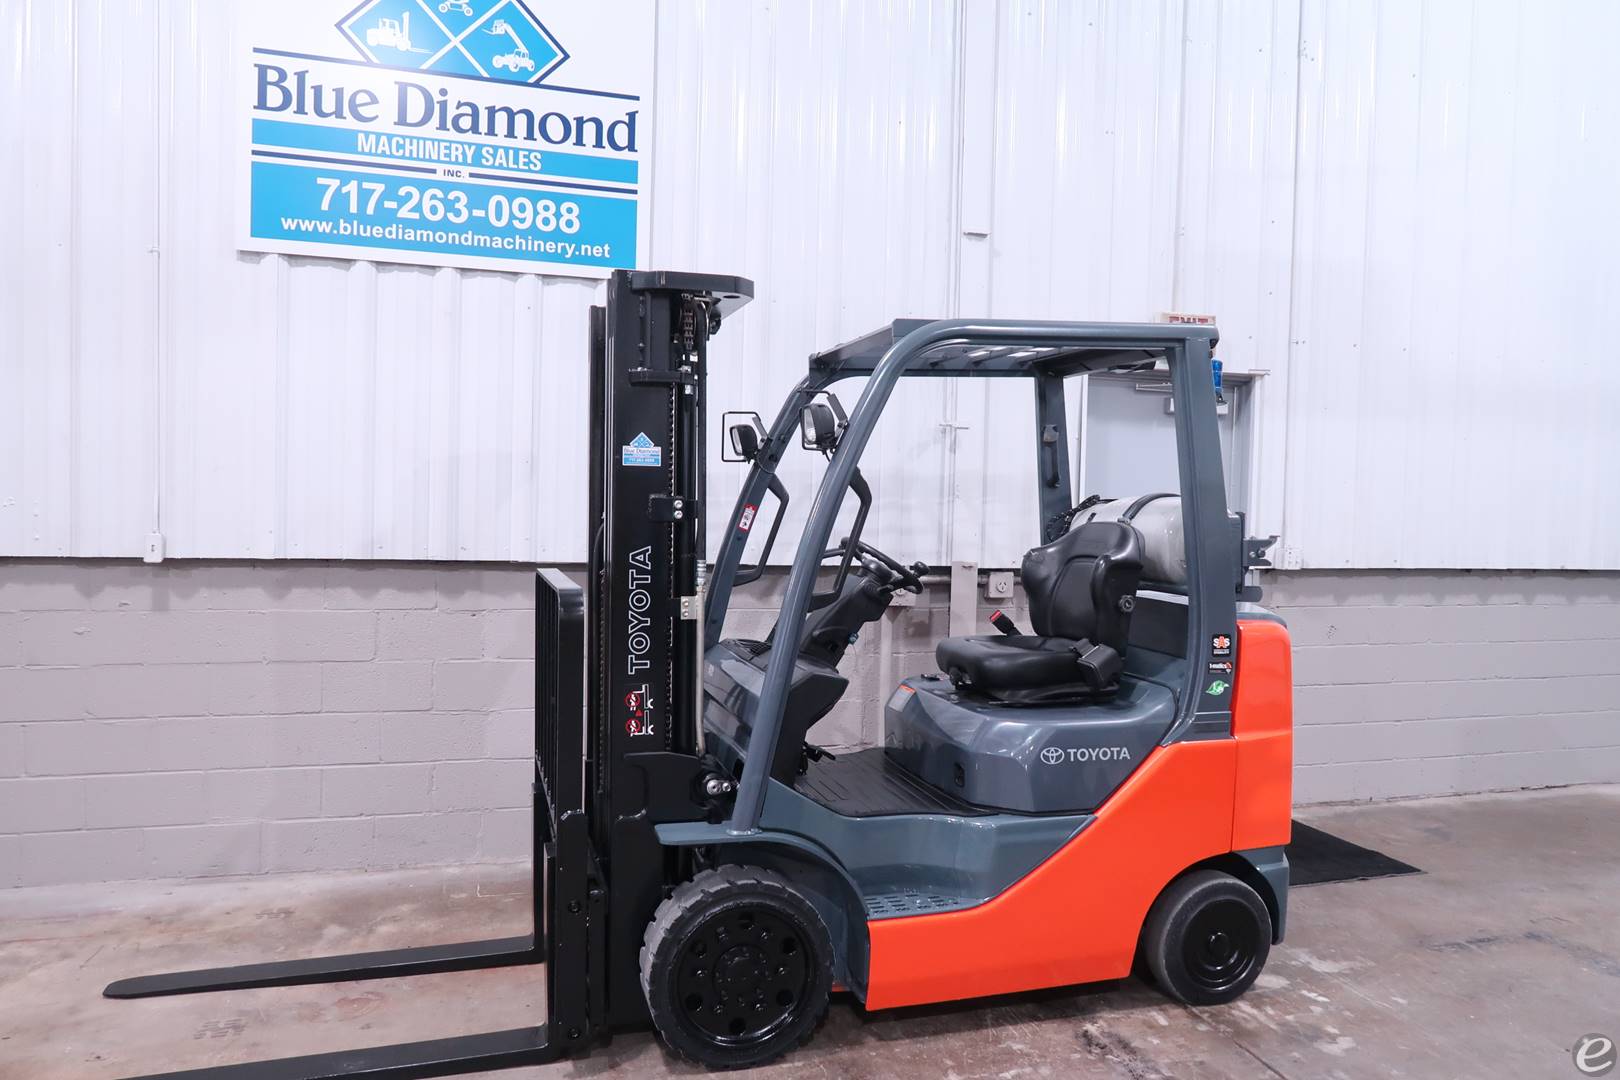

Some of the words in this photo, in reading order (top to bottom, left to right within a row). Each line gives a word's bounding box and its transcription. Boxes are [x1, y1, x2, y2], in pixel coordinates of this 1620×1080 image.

[253, 63, 380, 123] Blue
[393, 80, 639, 153] Diamond
[357, 132, 476, 164] MACHINERY
[481, 146, 542, 171] SALES
[443, 169, 465, 178] INC.
[316, 177, 581, 234] 717-263-0988
[281, 217, 611, 258] www.bluediamondmachinery.net
[628, 545, 651, 674] TOYOTA
[1067, 747, 1131, 762] TOYOTA
